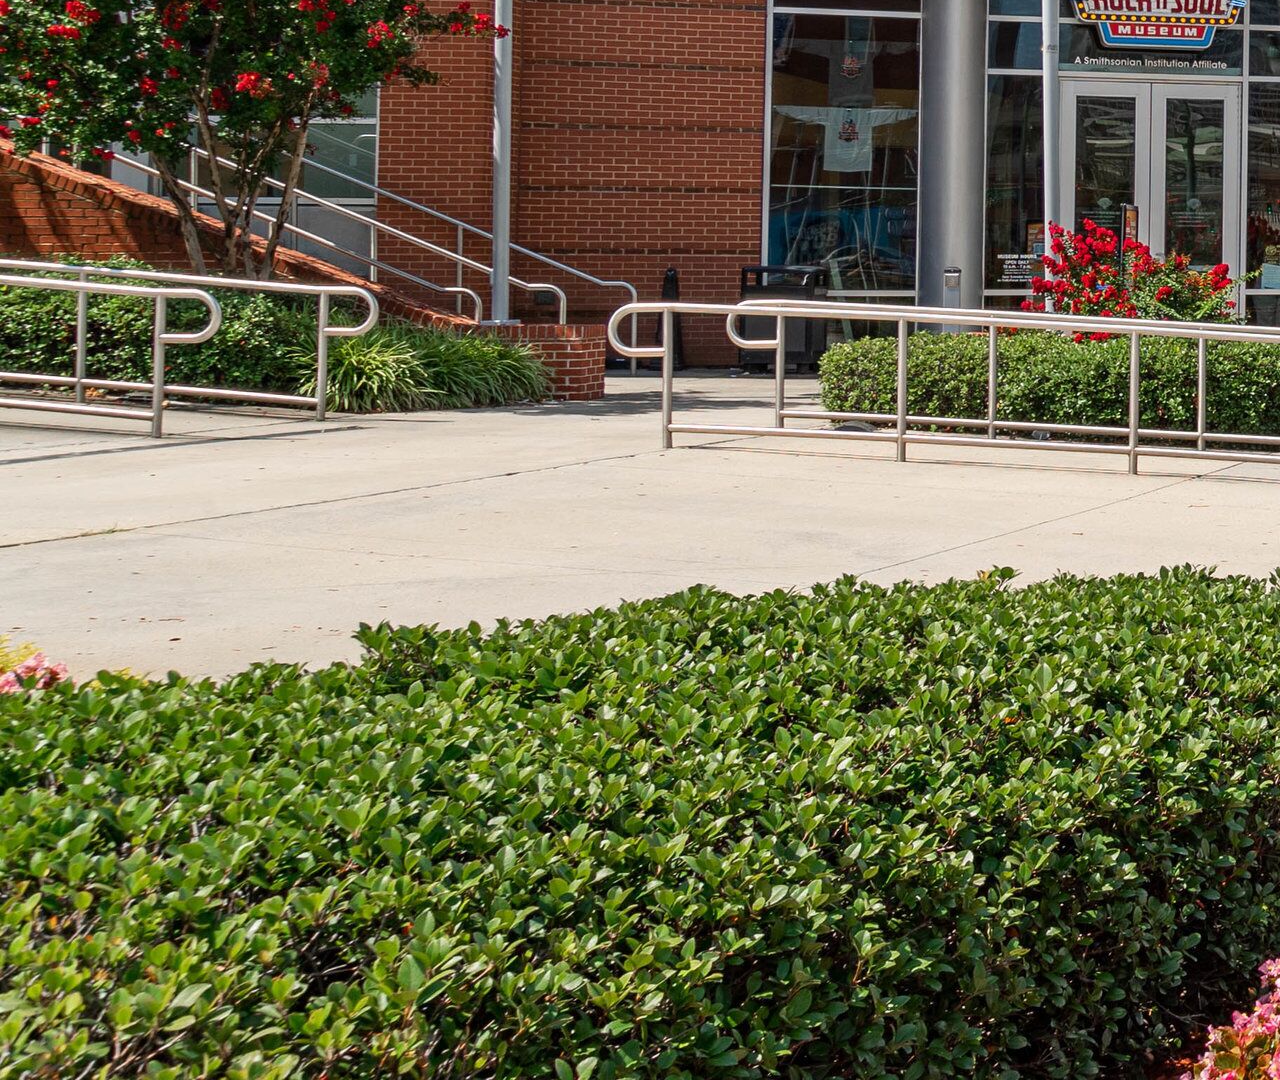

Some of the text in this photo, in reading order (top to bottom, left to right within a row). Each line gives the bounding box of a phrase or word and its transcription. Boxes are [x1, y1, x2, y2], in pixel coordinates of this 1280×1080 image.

[1074, 56, 1228, 70] A Smithsonian Institution Affiliate
